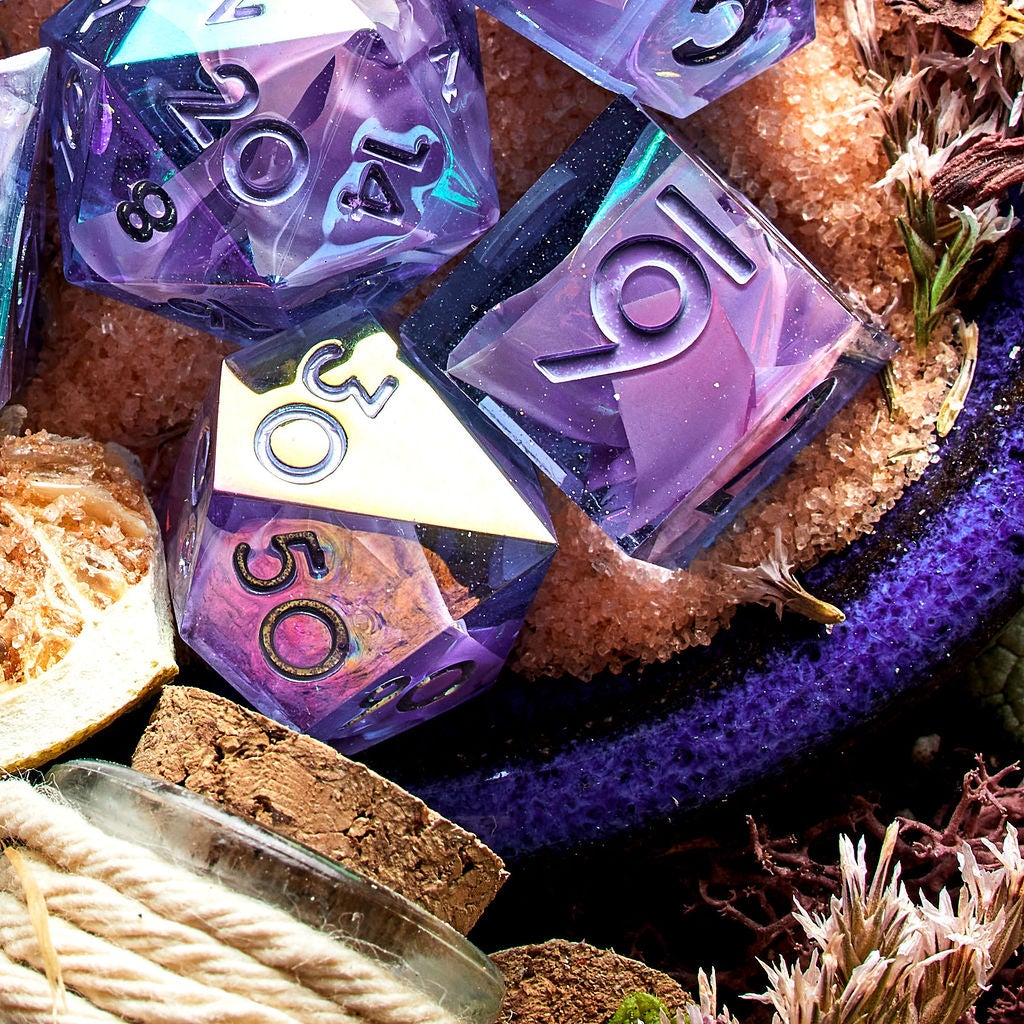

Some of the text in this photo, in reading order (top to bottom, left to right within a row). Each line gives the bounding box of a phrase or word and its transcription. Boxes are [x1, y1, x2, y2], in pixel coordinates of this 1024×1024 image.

[162, 63, 311, 207] 20
[340, 135, 433, 226] 14
[115, 179, 178, 243] 8
[254, 338, 400, 484] 30
[232, 530, 350, 682] 50
